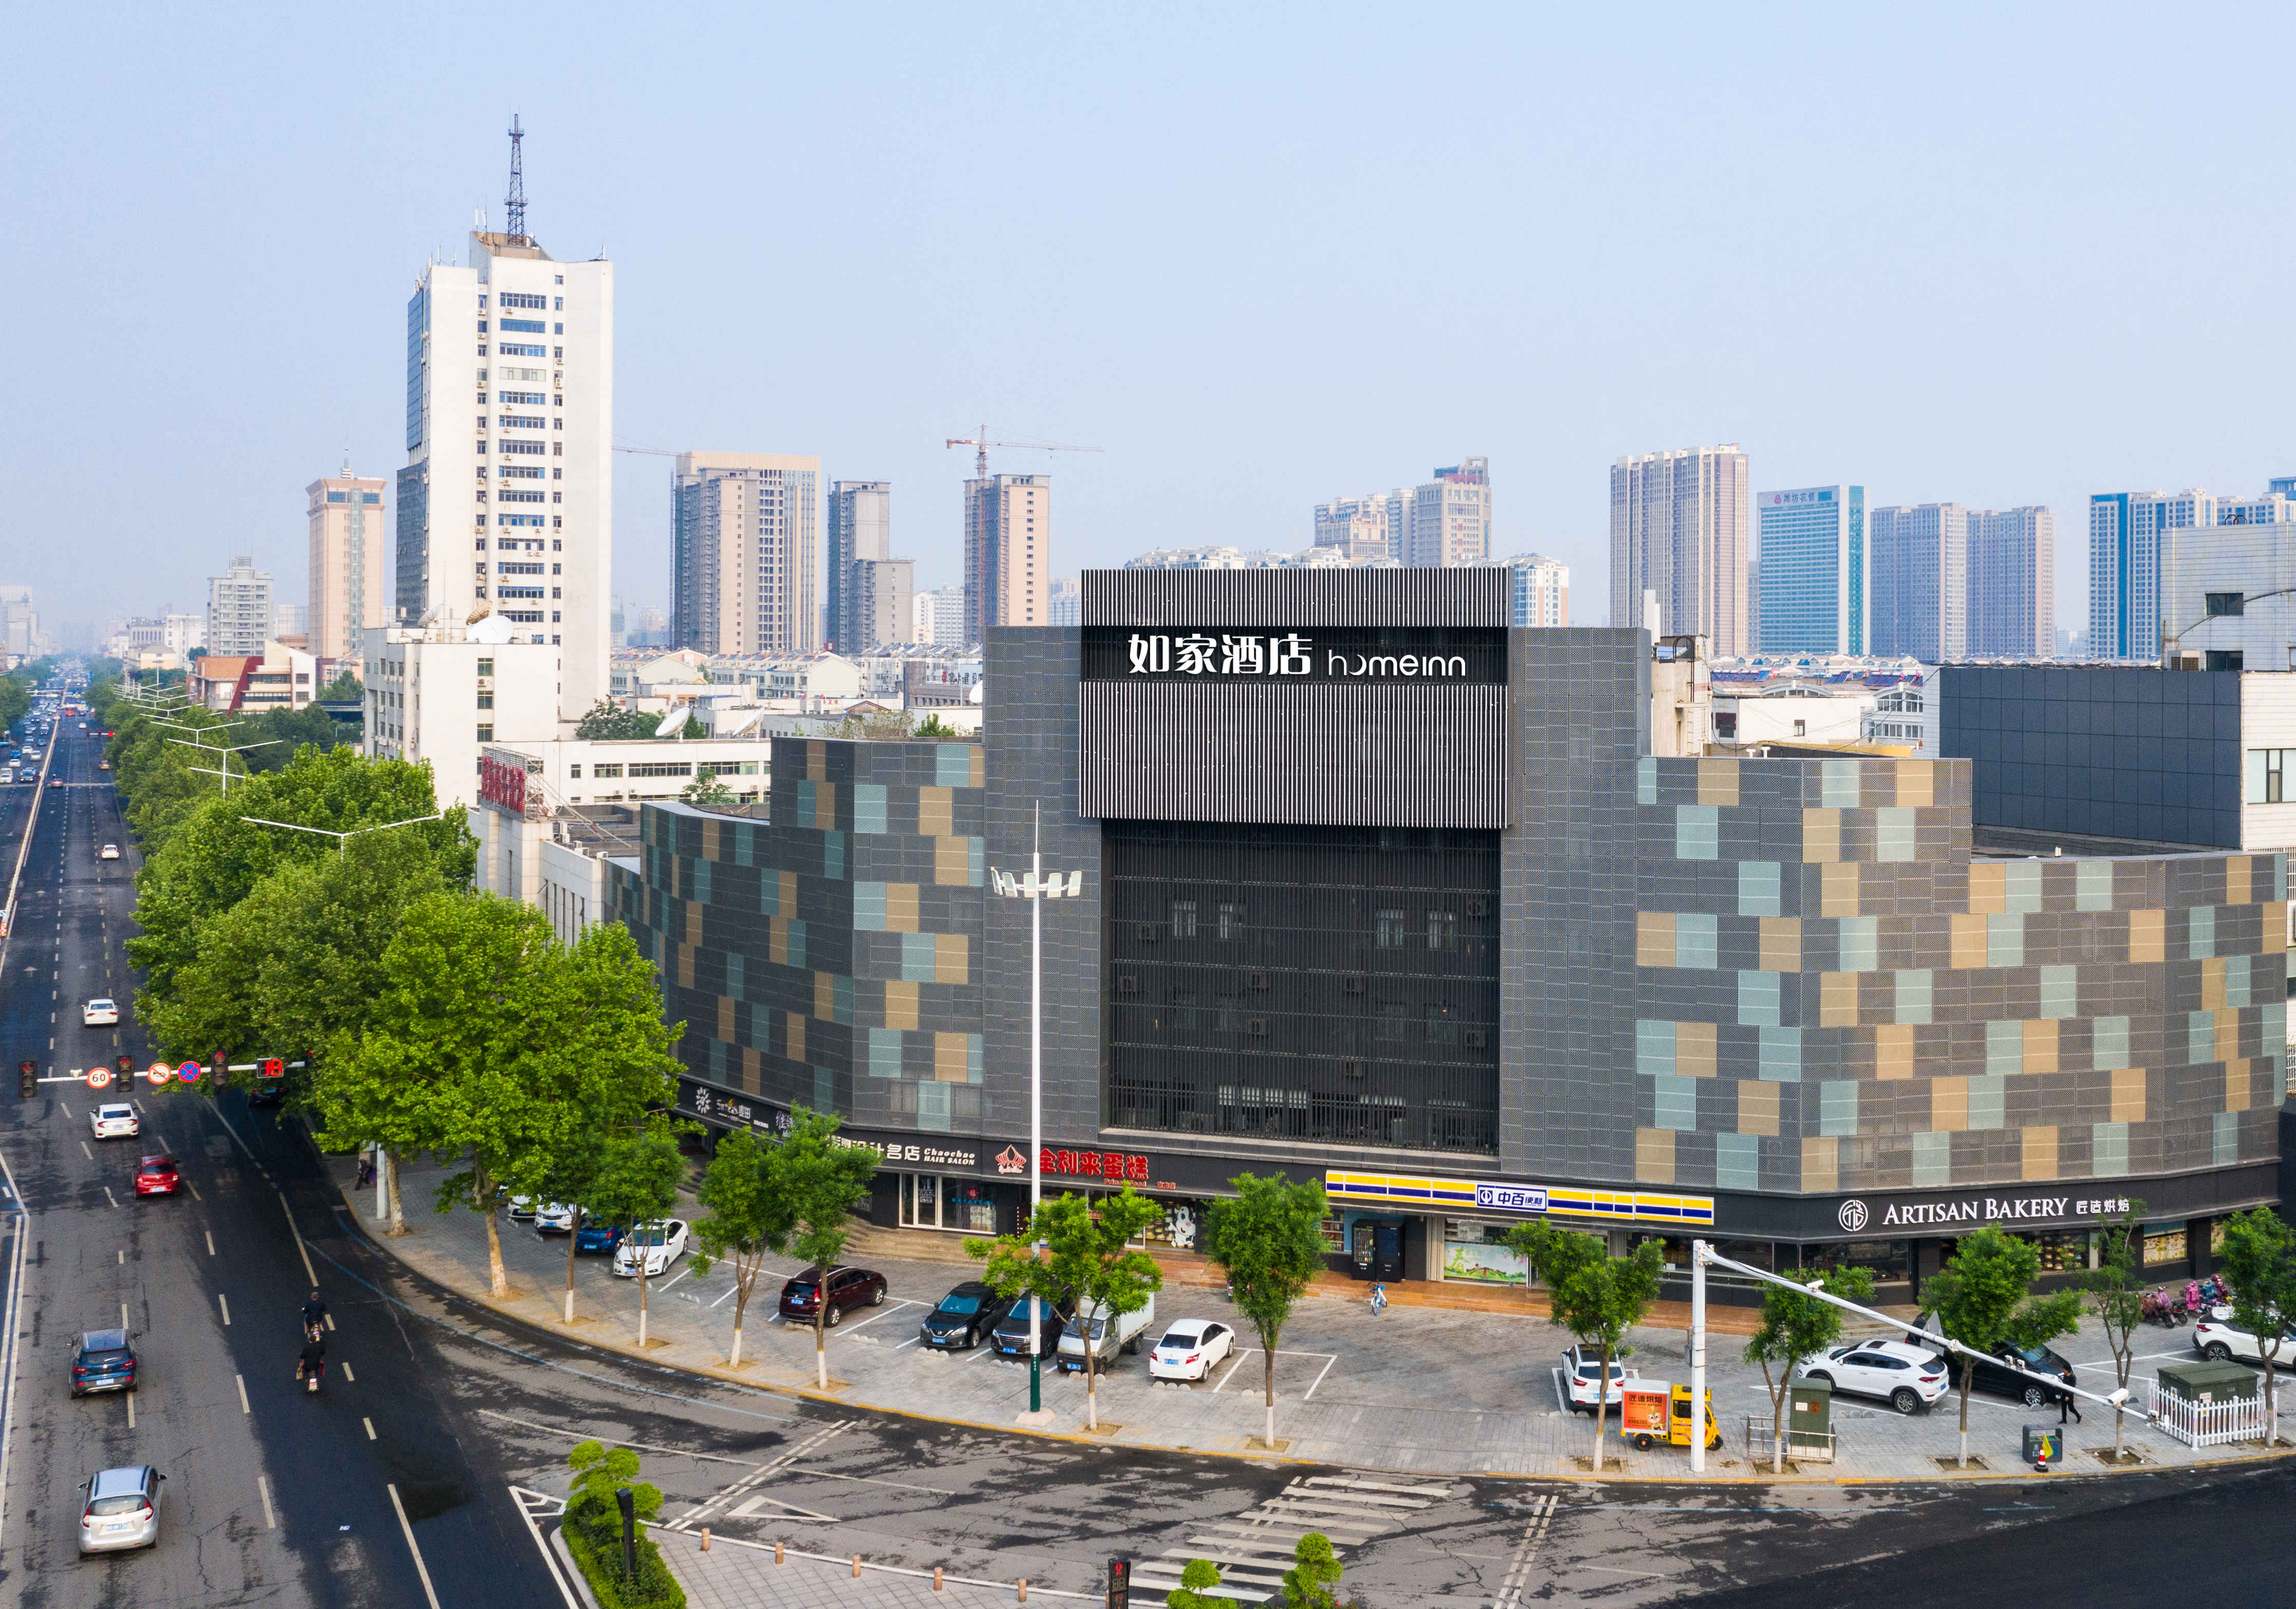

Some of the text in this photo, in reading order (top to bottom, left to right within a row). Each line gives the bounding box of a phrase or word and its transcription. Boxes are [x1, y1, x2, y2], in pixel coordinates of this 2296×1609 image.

[1783, 491, 1815, 503] 潍坊农信
[1128, 633, 1313, 676] 如家酒店
[92, 1073, 106, 1082] 60
[924, 1148, 975, 1159] Chaochao
[924, 1155, 975, 1166] HAIR SALON
[1882, 1197, 2069, 1225] ARTISAN BAKERY
[2076, 1198, 2130, 1215] 匠造烘焙
[1629, 1394, 1662, 1404] 匠造烘焙
